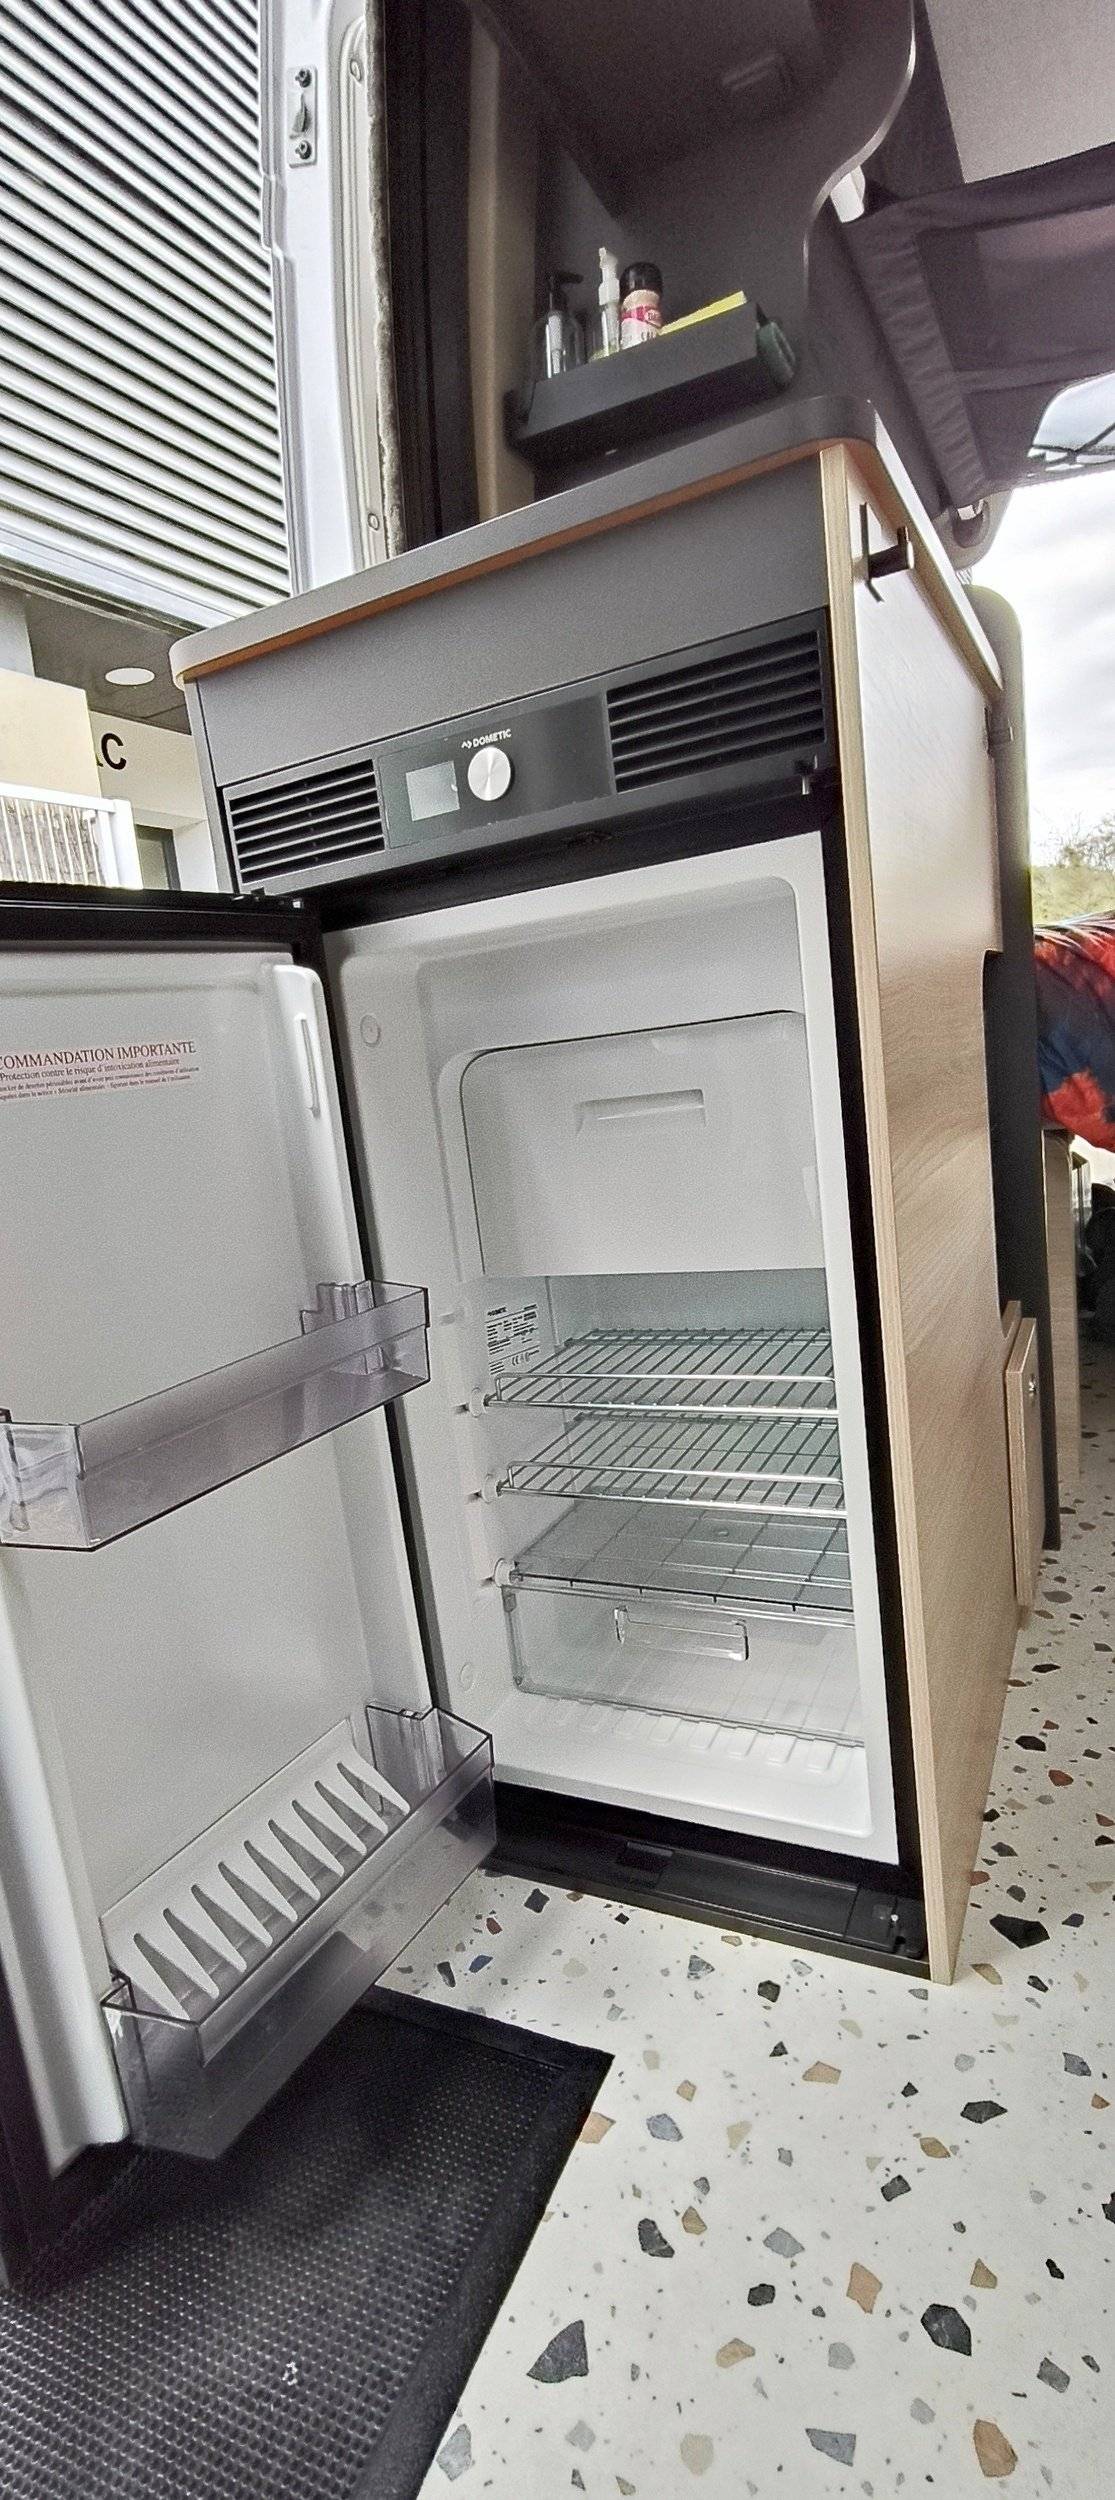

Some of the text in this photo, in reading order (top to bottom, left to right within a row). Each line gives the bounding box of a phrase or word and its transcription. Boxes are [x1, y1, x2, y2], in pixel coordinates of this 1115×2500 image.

[473, 728, 512, 747] DOMETIC
[96, 733, 127, 770] C
[117, 1041, 197, 1060] IMPORTANTE
[0, 1071, 41, 1081] Protection
[41, 1069, 65, 1078] contre
[66, 1067, 73, 1075] le
[75, 1066, 96, 1076] risque
